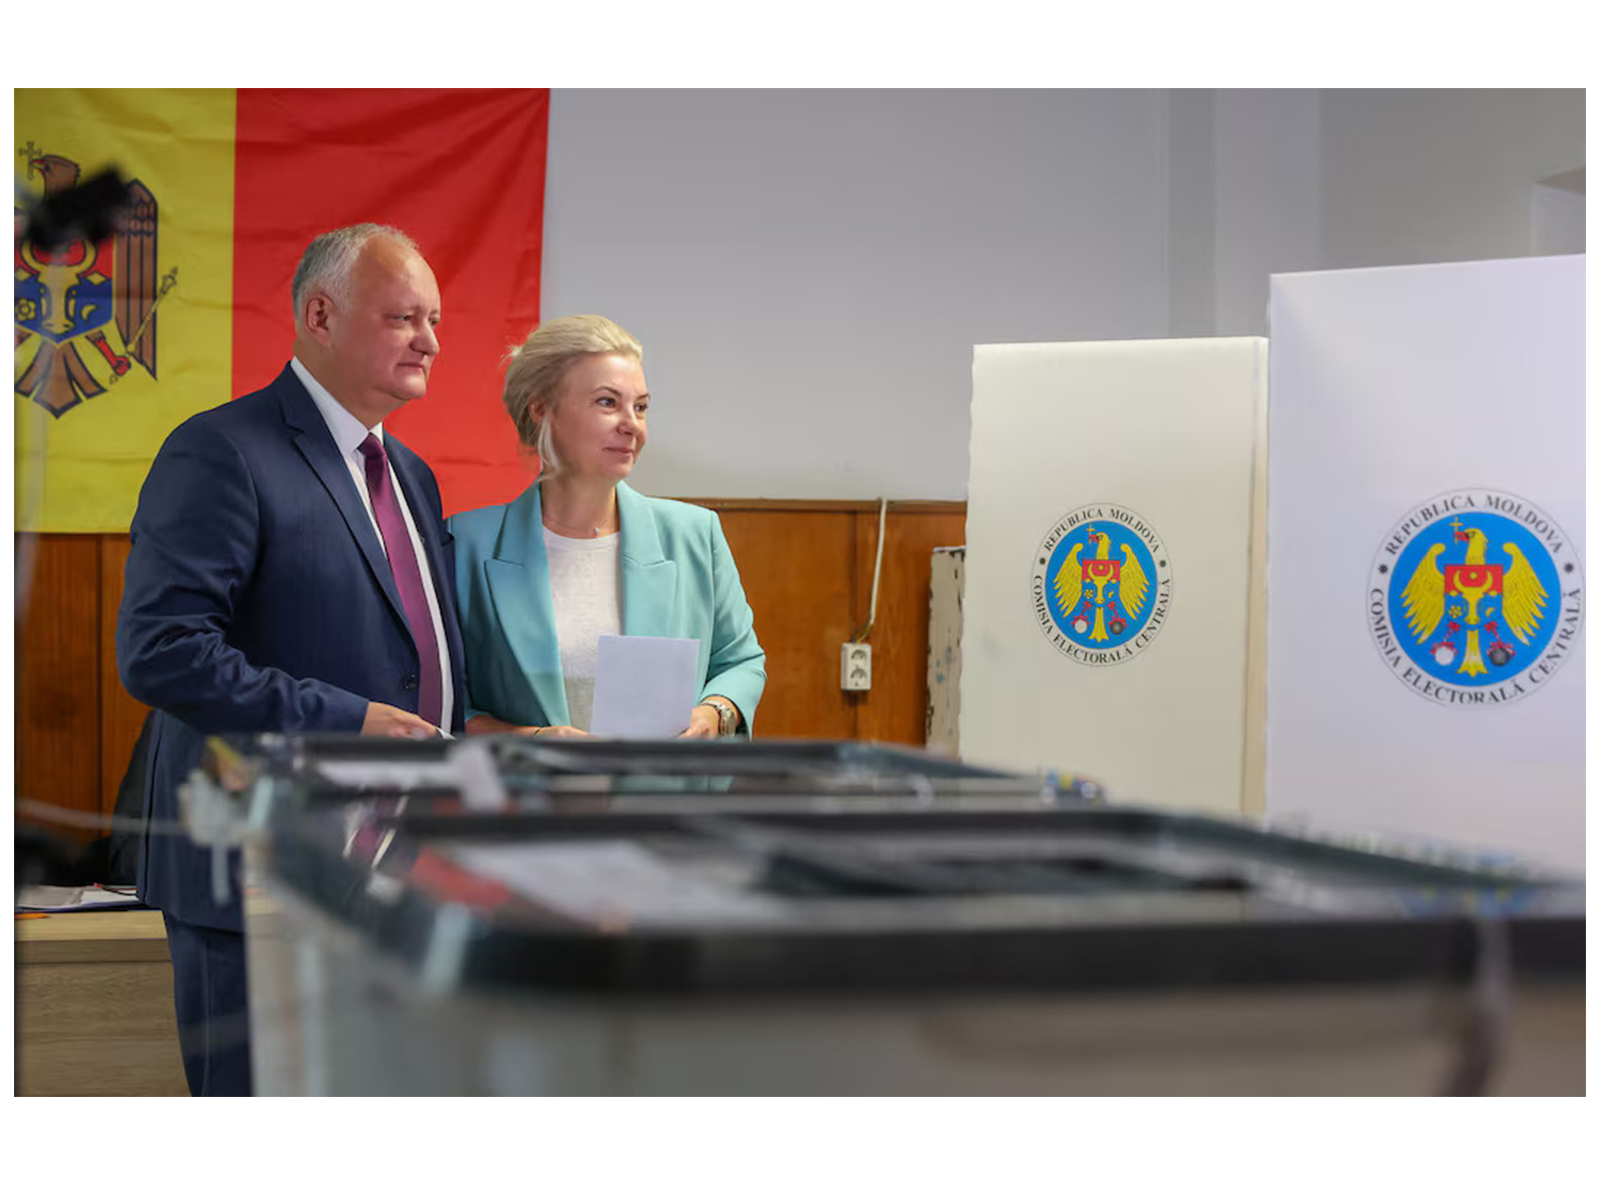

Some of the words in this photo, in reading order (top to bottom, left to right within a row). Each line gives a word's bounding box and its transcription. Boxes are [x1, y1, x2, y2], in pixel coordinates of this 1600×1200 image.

[1044, 508, 1103, 552] REPUBLICA
[1109, 508, 1160, 553] MOLDOVA
[1385, 495, 1475, 555] REPUBLICA
[1485, 495, 1563, 553] MOLDOVA
[1033, 575, 1054, 634] COMISIA
[1053, 633, 1133, 664] ELECTORALĂ
[1135, 578, 1170, 649] CENTRALĂ
[1370, 588, 1402, 668] COMISIA
[1402, 667, 1525, 704] ELECTORALĂ
[1529, 588, 1581, 684] CENTRALĂ
